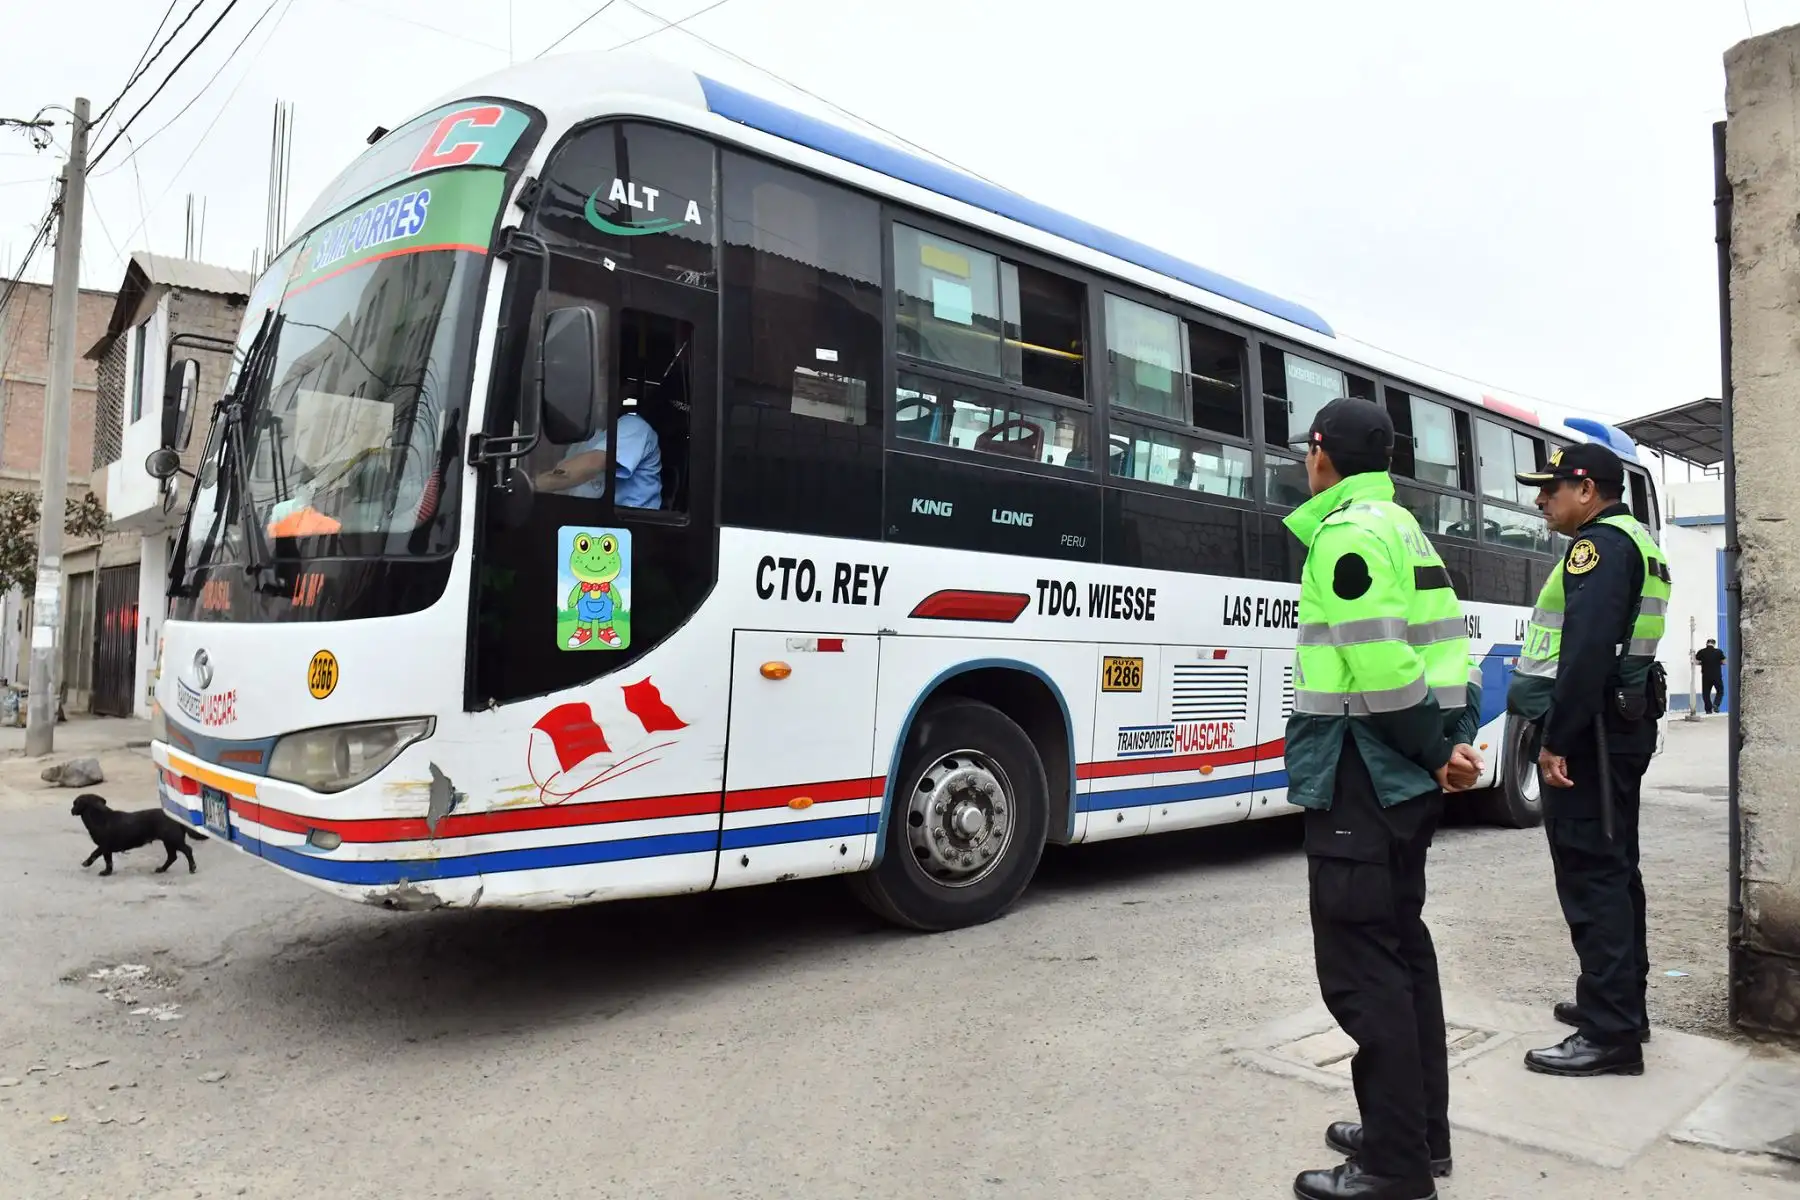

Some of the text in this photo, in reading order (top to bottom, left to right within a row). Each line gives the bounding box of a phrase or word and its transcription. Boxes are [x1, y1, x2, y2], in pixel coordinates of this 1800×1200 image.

[409, 105, 504, 174] C
[608, 178, 702, 225] ALT A
[911, 498, 1034, 527] KING LONG
[1060, 534, 1086, 548] PERU
[755, 555, 822, 603] CTO.
[832, 562, 889, 606] REY
[1036, 579, 1081, 617] TDO.
[1088, 583, 1157, 621] WIESSE
[1223, 595, 1252, 627] LAS
[1255, 598, 1299, 629] FLORE
[311, 658, 333, 690] 2366
[1105, 666, 1140, 687] 1286
[1117, 730, 1175, 751] TRANSPORTES
[1174, 722, 1229, 752] HUASCAR
